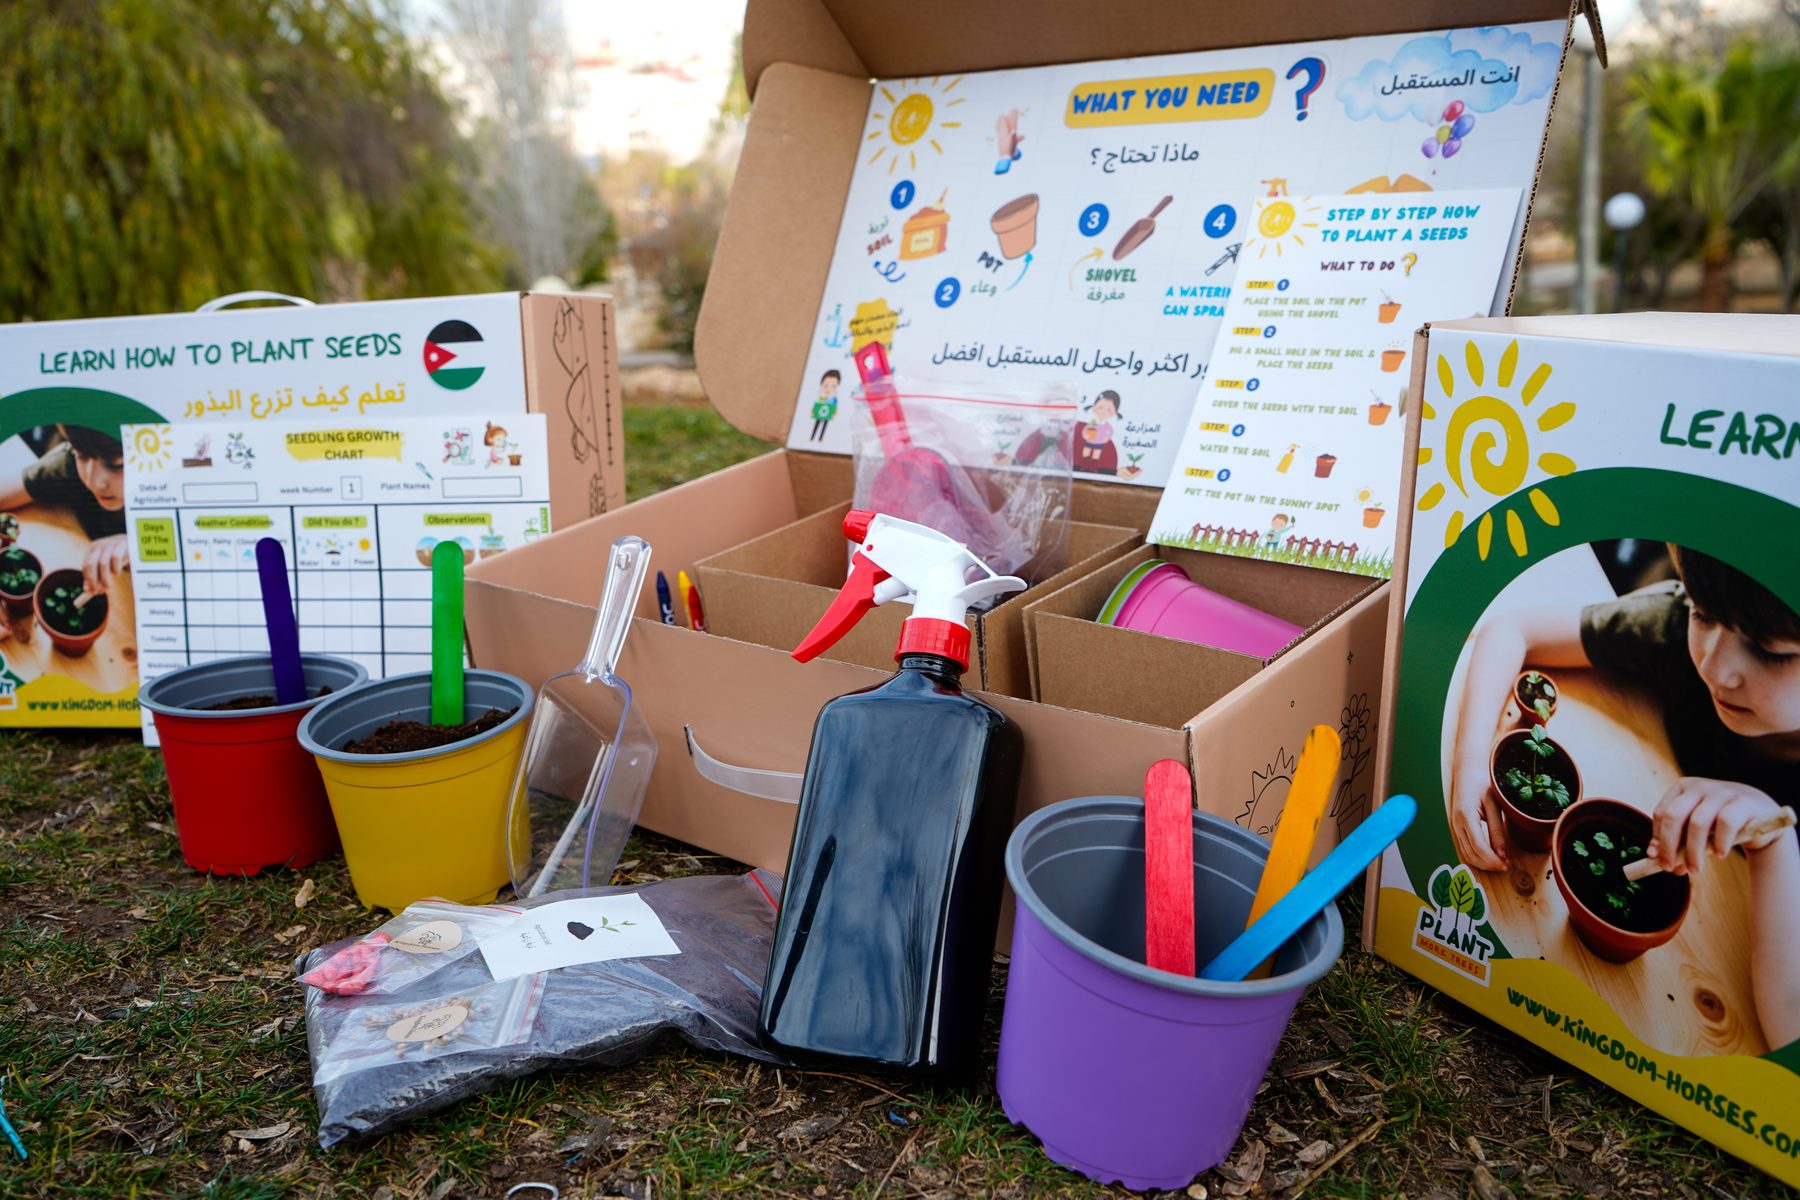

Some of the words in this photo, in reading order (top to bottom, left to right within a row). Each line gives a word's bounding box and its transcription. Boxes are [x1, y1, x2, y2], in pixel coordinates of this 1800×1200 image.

[1381, 69, 1476, 95] المستقبل
[1480, 66, 1521, 84] انت
[1072, 90, 1136, 115] WHAT
[1144, 86, 1190, 109] YOU
[1196, 82, 1260, 107] NEED
[1104, 143, 1156, 173] تحتاج
[1163, 143, 1200, 164] ماذا
[898, 187, 908, 204] 1
[1088, 212, 1100, 228] 3
[1327, 207, 1365, 222] STEP
[1371, 207, 1392, 221] BY
[1397, 206, 1437, 220] STEP
[1442, 205, 1481, 219] HOW
[1212, 214, 1226, 230] 4
[1321, 230, 1340, 242] TO
[1345, 228, 1398, 242] PLANT
[1401, 229, 1413, 241] A
[1419, 227, 1468, 240] SEEDS
[867, 234, 893, 256] SOIL
[977, 250, 1004, 274] POT
[1320, 261, 1355, 272] WHAT
[1359, 261, 1375, 271] TO
[1379, 260, 1396, 271] DO
[1085, 268, 1138, 283] SHOVEL
[970, 280, 998, 297] وعاء
[1165, 286, 1175, 297] A
[1249, 280, 1268, 289] STEP
[942, 284, 954, 301] 2
[1087, 286, 1126, 304] مغرفة
[1244, 296, 1270, 306] PLACE
[1273, 296, 1290, 305] THE
[1292, 297, 1311, 305] SOIL
[1314, 297, 1325, 306] IN
[1329, 297, 1347, 306] THE
[1349, 298, 1367, 306] POT
[1163, 305, 1189, 316] CAN
[1193, 305, 1225, 317] SPRA
[1258, 309, 1281, 319] USING
[1284, 310, 1301, 318] THE
[1304, 310, 1340, 319] SHOVEL
[1235, 327, 1255, 336] STEP
[40, 348, 116, 374] LEARN
[126, 346, 176, 370] HOW
[186, 344, 222, 366] TO
[232, 337, 314, 364] PLANT
[324, 333, 402, 359] SEEDS
[932, 342, 984, 367] افضل
[987, 345, 1079, 369] المستقبل
[1229, 346, 1243, 355] DIG
[1245, 347, 1252, 355] A
[1254, 347, 1282, 356] SMALL
[1286, 347, 1307, 357] HOLE
[1310, 348, 1320, 357] IN
[1323, 348, 1341, 357] THE
[1344, 349, 1365, 358] SOIL
[1082, 348, 1144, 374] واجعل
[1150, 352, 1188, 375] اكثر
[1257, 360, 1282, 369] PLACE
[1284, 360, 1301, 369] THE
[1305, 361, 1334, 370] SEEDS
[1220, 380, 1240, 389] STEP
[183, 389, 242, 418] البذور
[250, 388, 293, 419] تزرع
[301, 385, 350, 408] كيف
[358, 383, 406, 414] تعلم
[1212, 399, 1239, 409] COVER
[1243, 401, 1260, 410] THE
[1261, 402, 1288, 412] SEEDS
[1292, 404, 1315, 414] WITH
[1318, 405, 1336, 415] THE
[1339, 406, 1358, 416] SOIL
[1205, 422, 1225, 431] STEP
[286, 431, 344, 445] SEEDLING
[347, 430, 401, 444] GROWTH
[324, 449, 365, 461] CHART
[1200, 444, 1229, 454] WATER
[1233, 446, 1250, 456] THE
[1252, 447, 1271, 457] SOIL
[1190, 468, 1209, 477] STEP
[139, 484, 157, 493] Date
[158, 483, 168, 492] of
[280, 487, 300, 495] week
[302, 486, 334, 494] Number
[348, 483, 355, 494] 1
[380, 482, 402, 491] Plant
[402, 481, 431, 491] Names
[133, 495, 177, 506] Agriculture
[1184, 487, 1201, 496] PUT
[1205, 489, 1222, 499] THE
[1225, 491, 1242, 501] POT
[1244, 494, 1256, 503] IN
[1259, 495, 1277, 505] THE
[1280, 498, 1312, 510] SUNNY
[1315, 501, 1341, 512] SPOT
[194, 519, 228, 528] Weather
[230, 518, 274, 528] Conditions
[308, 518, 323, 527] Did
[325, 518, 340, 527] You
[341, 518, 353, 527] do
[428, 515, 486, 525] Observations
[143, 523, 165, 533] Days
[155, 536, 169, 544] The
[145, 549, 168, 557] Week
[149, 608, 175, 616] Monday
[150, 635, 177, 644] Tuesday
[1419, 910, 1490, 961] PLANT
[1419, 937, 1448, 959] MORE
[1450, 948, 1481, 976] TREES
